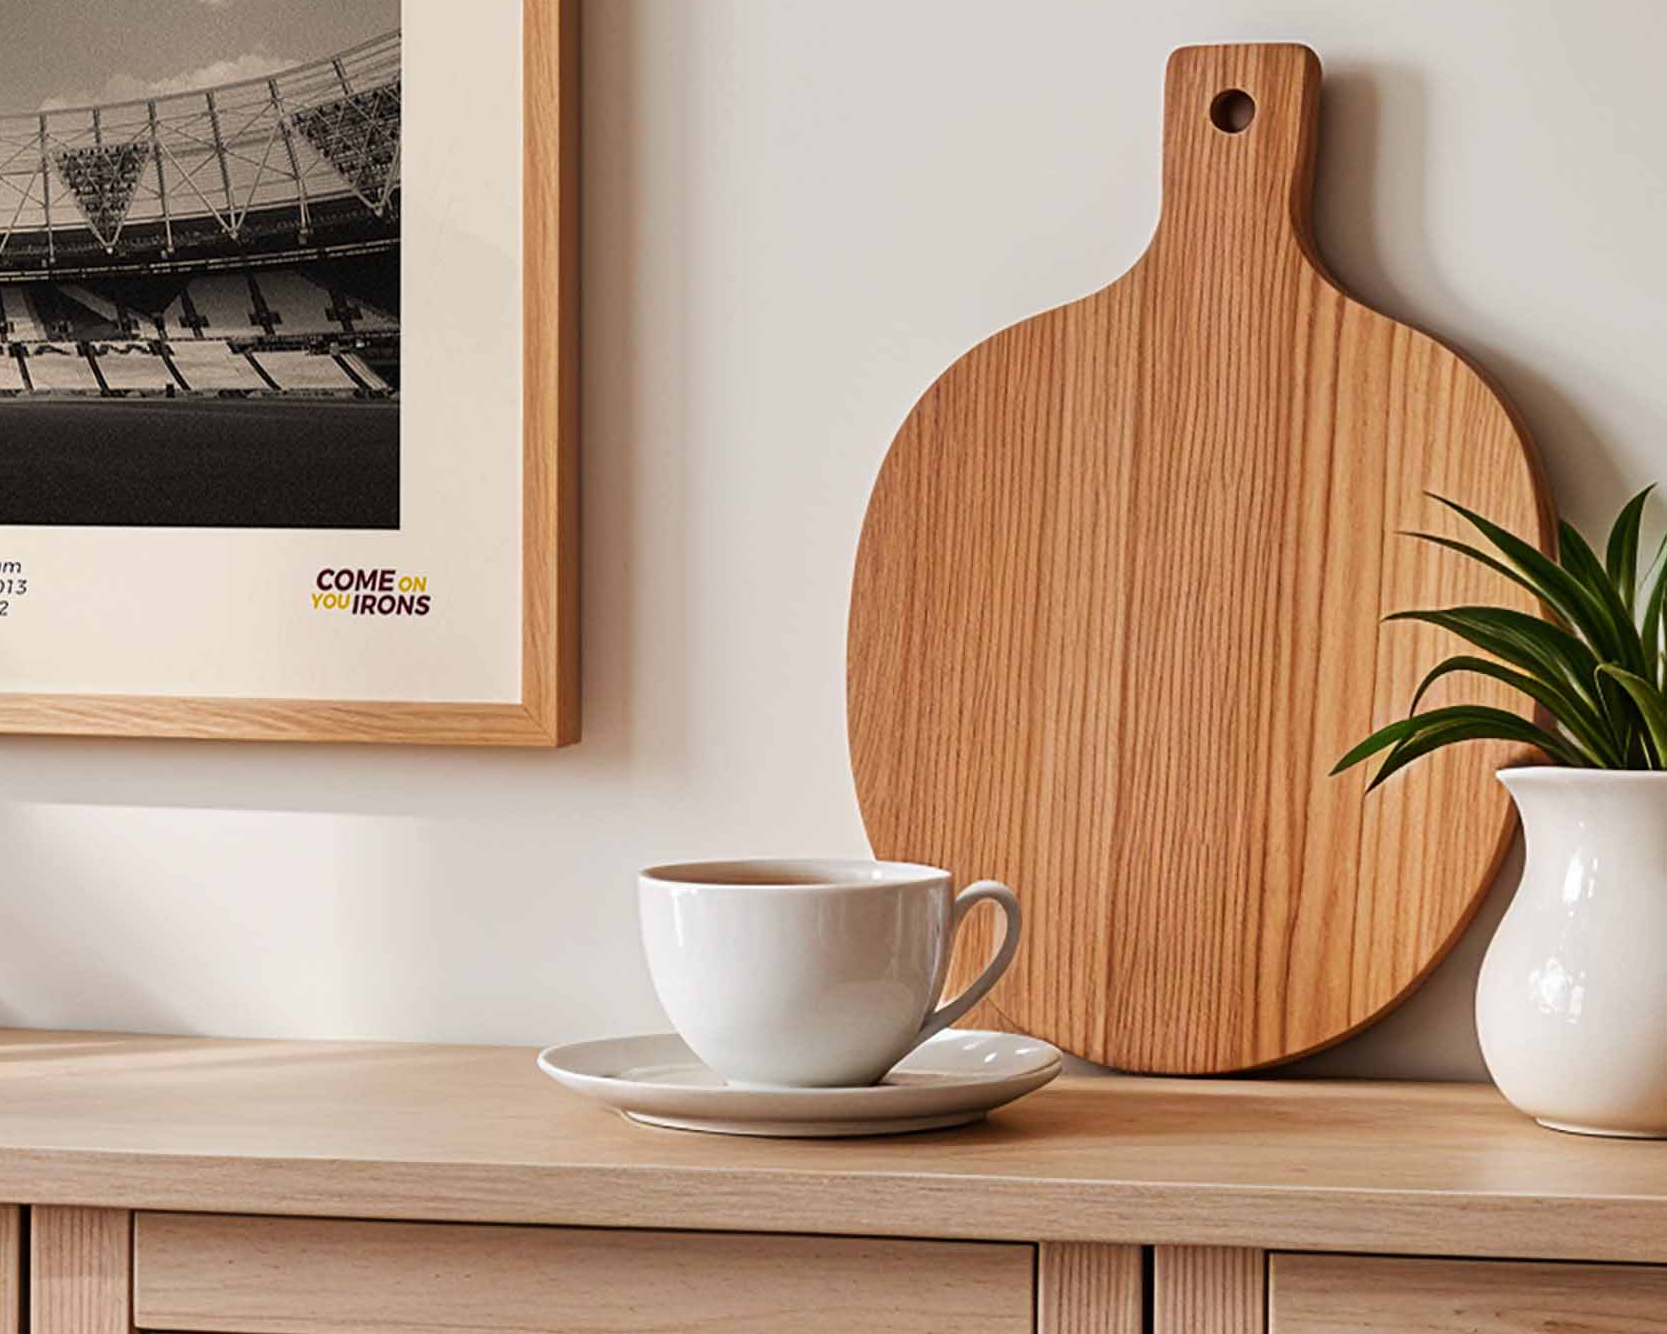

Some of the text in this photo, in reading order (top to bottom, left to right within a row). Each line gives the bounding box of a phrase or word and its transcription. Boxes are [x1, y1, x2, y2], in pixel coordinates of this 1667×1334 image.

[316, 568, 427, 593] COME ON
[311, 592, 431, 616] YOU IRONS
